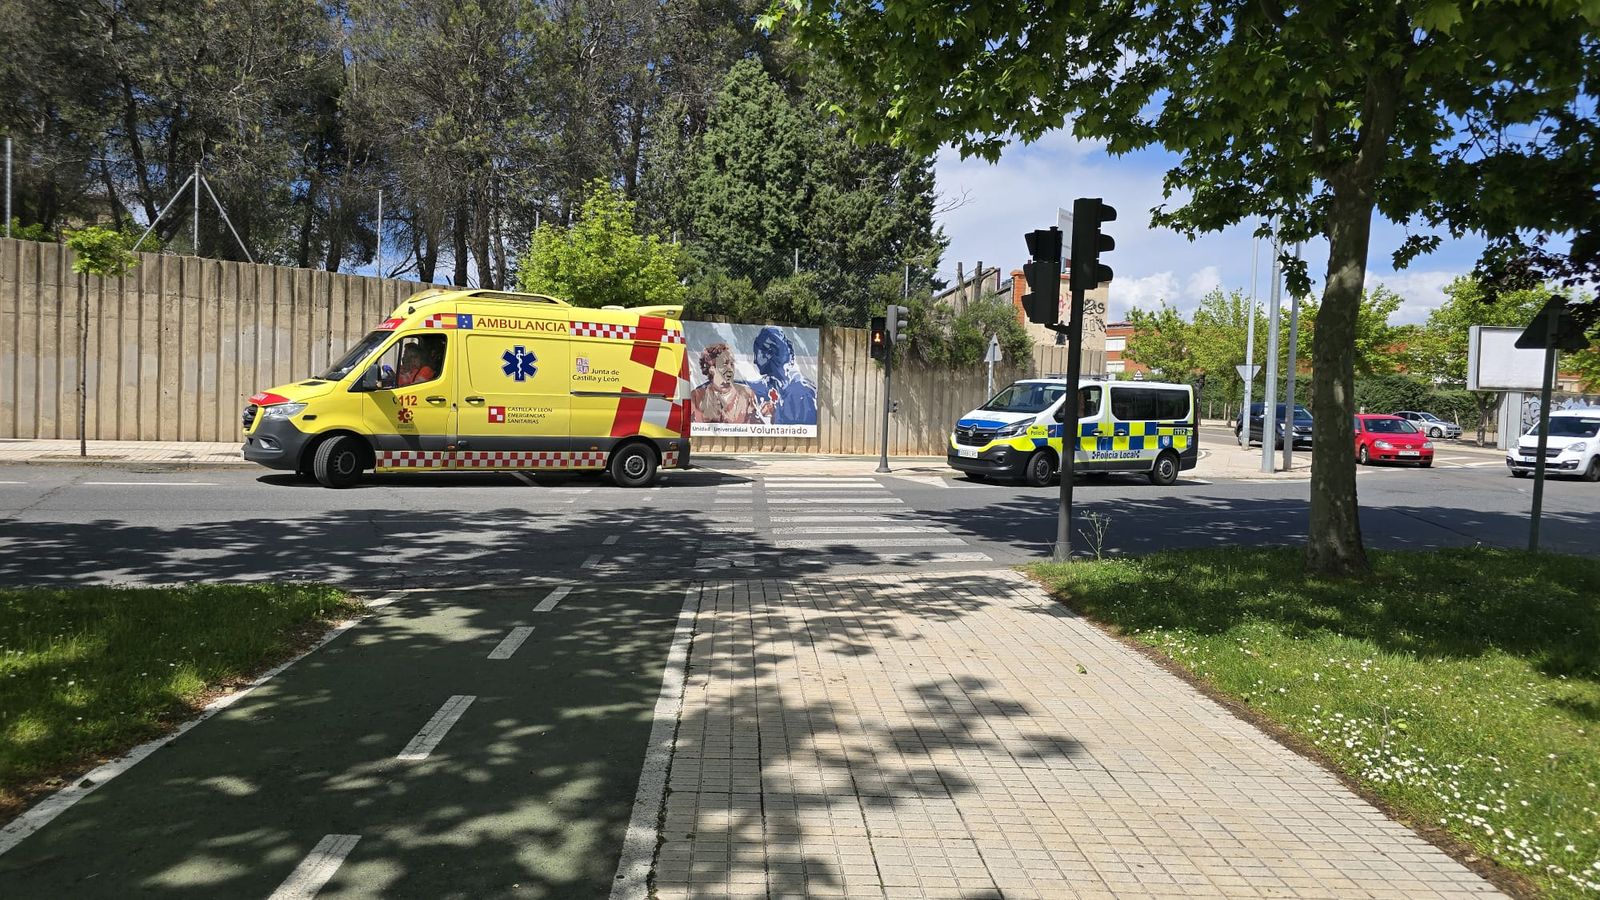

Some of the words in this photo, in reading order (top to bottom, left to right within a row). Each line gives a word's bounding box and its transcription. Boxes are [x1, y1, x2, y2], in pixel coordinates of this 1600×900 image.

[476, 318, 567, 332] AMBULANCIA
[399, 395, 418, 406] 112
[749, 426, 808, 435] Voluntariado
[1119, 451, 1136, 459] Local
